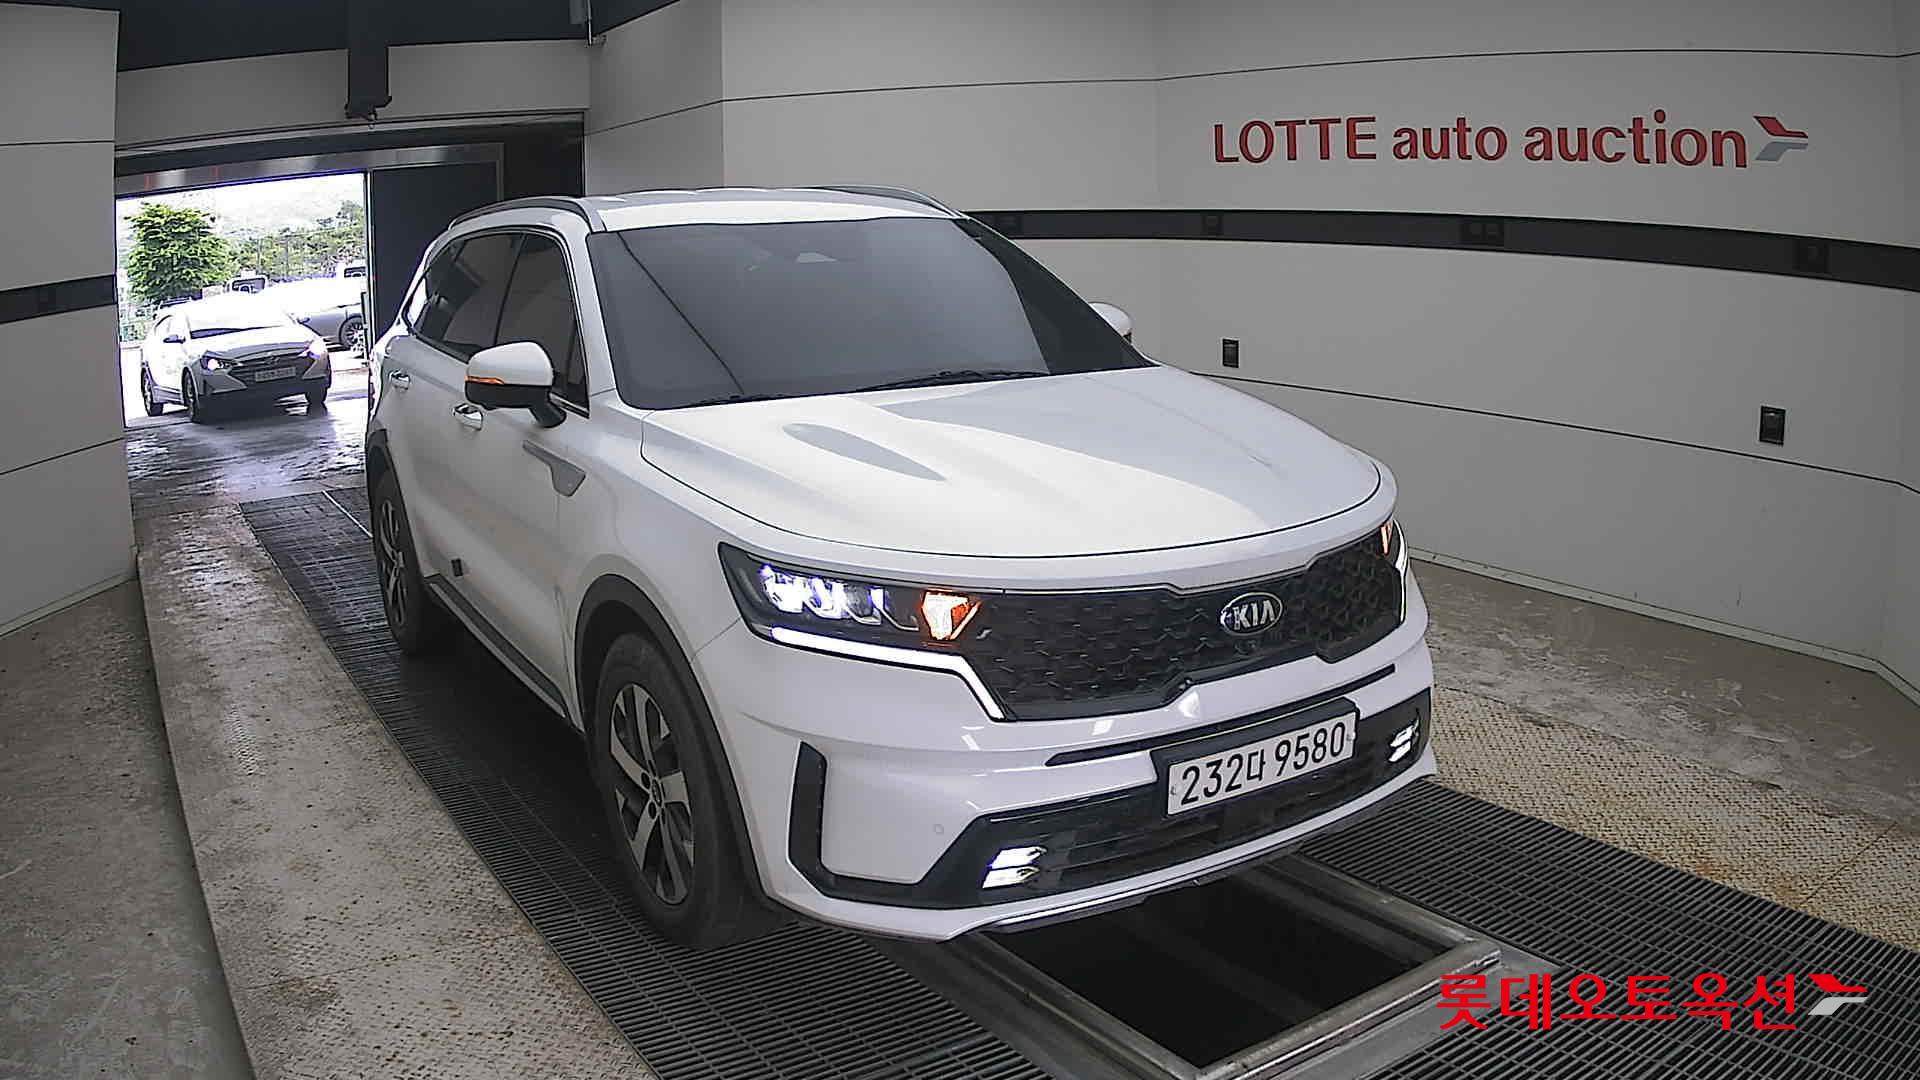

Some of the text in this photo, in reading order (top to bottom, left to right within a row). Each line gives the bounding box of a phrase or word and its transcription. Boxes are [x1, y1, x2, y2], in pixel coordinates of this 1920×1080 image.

[1213, 109, 1748, 168] LOTTE auto auction
[1232, 600, 1276, 631] KIA
[1181, 722, 1346, 805] 232다 9580
